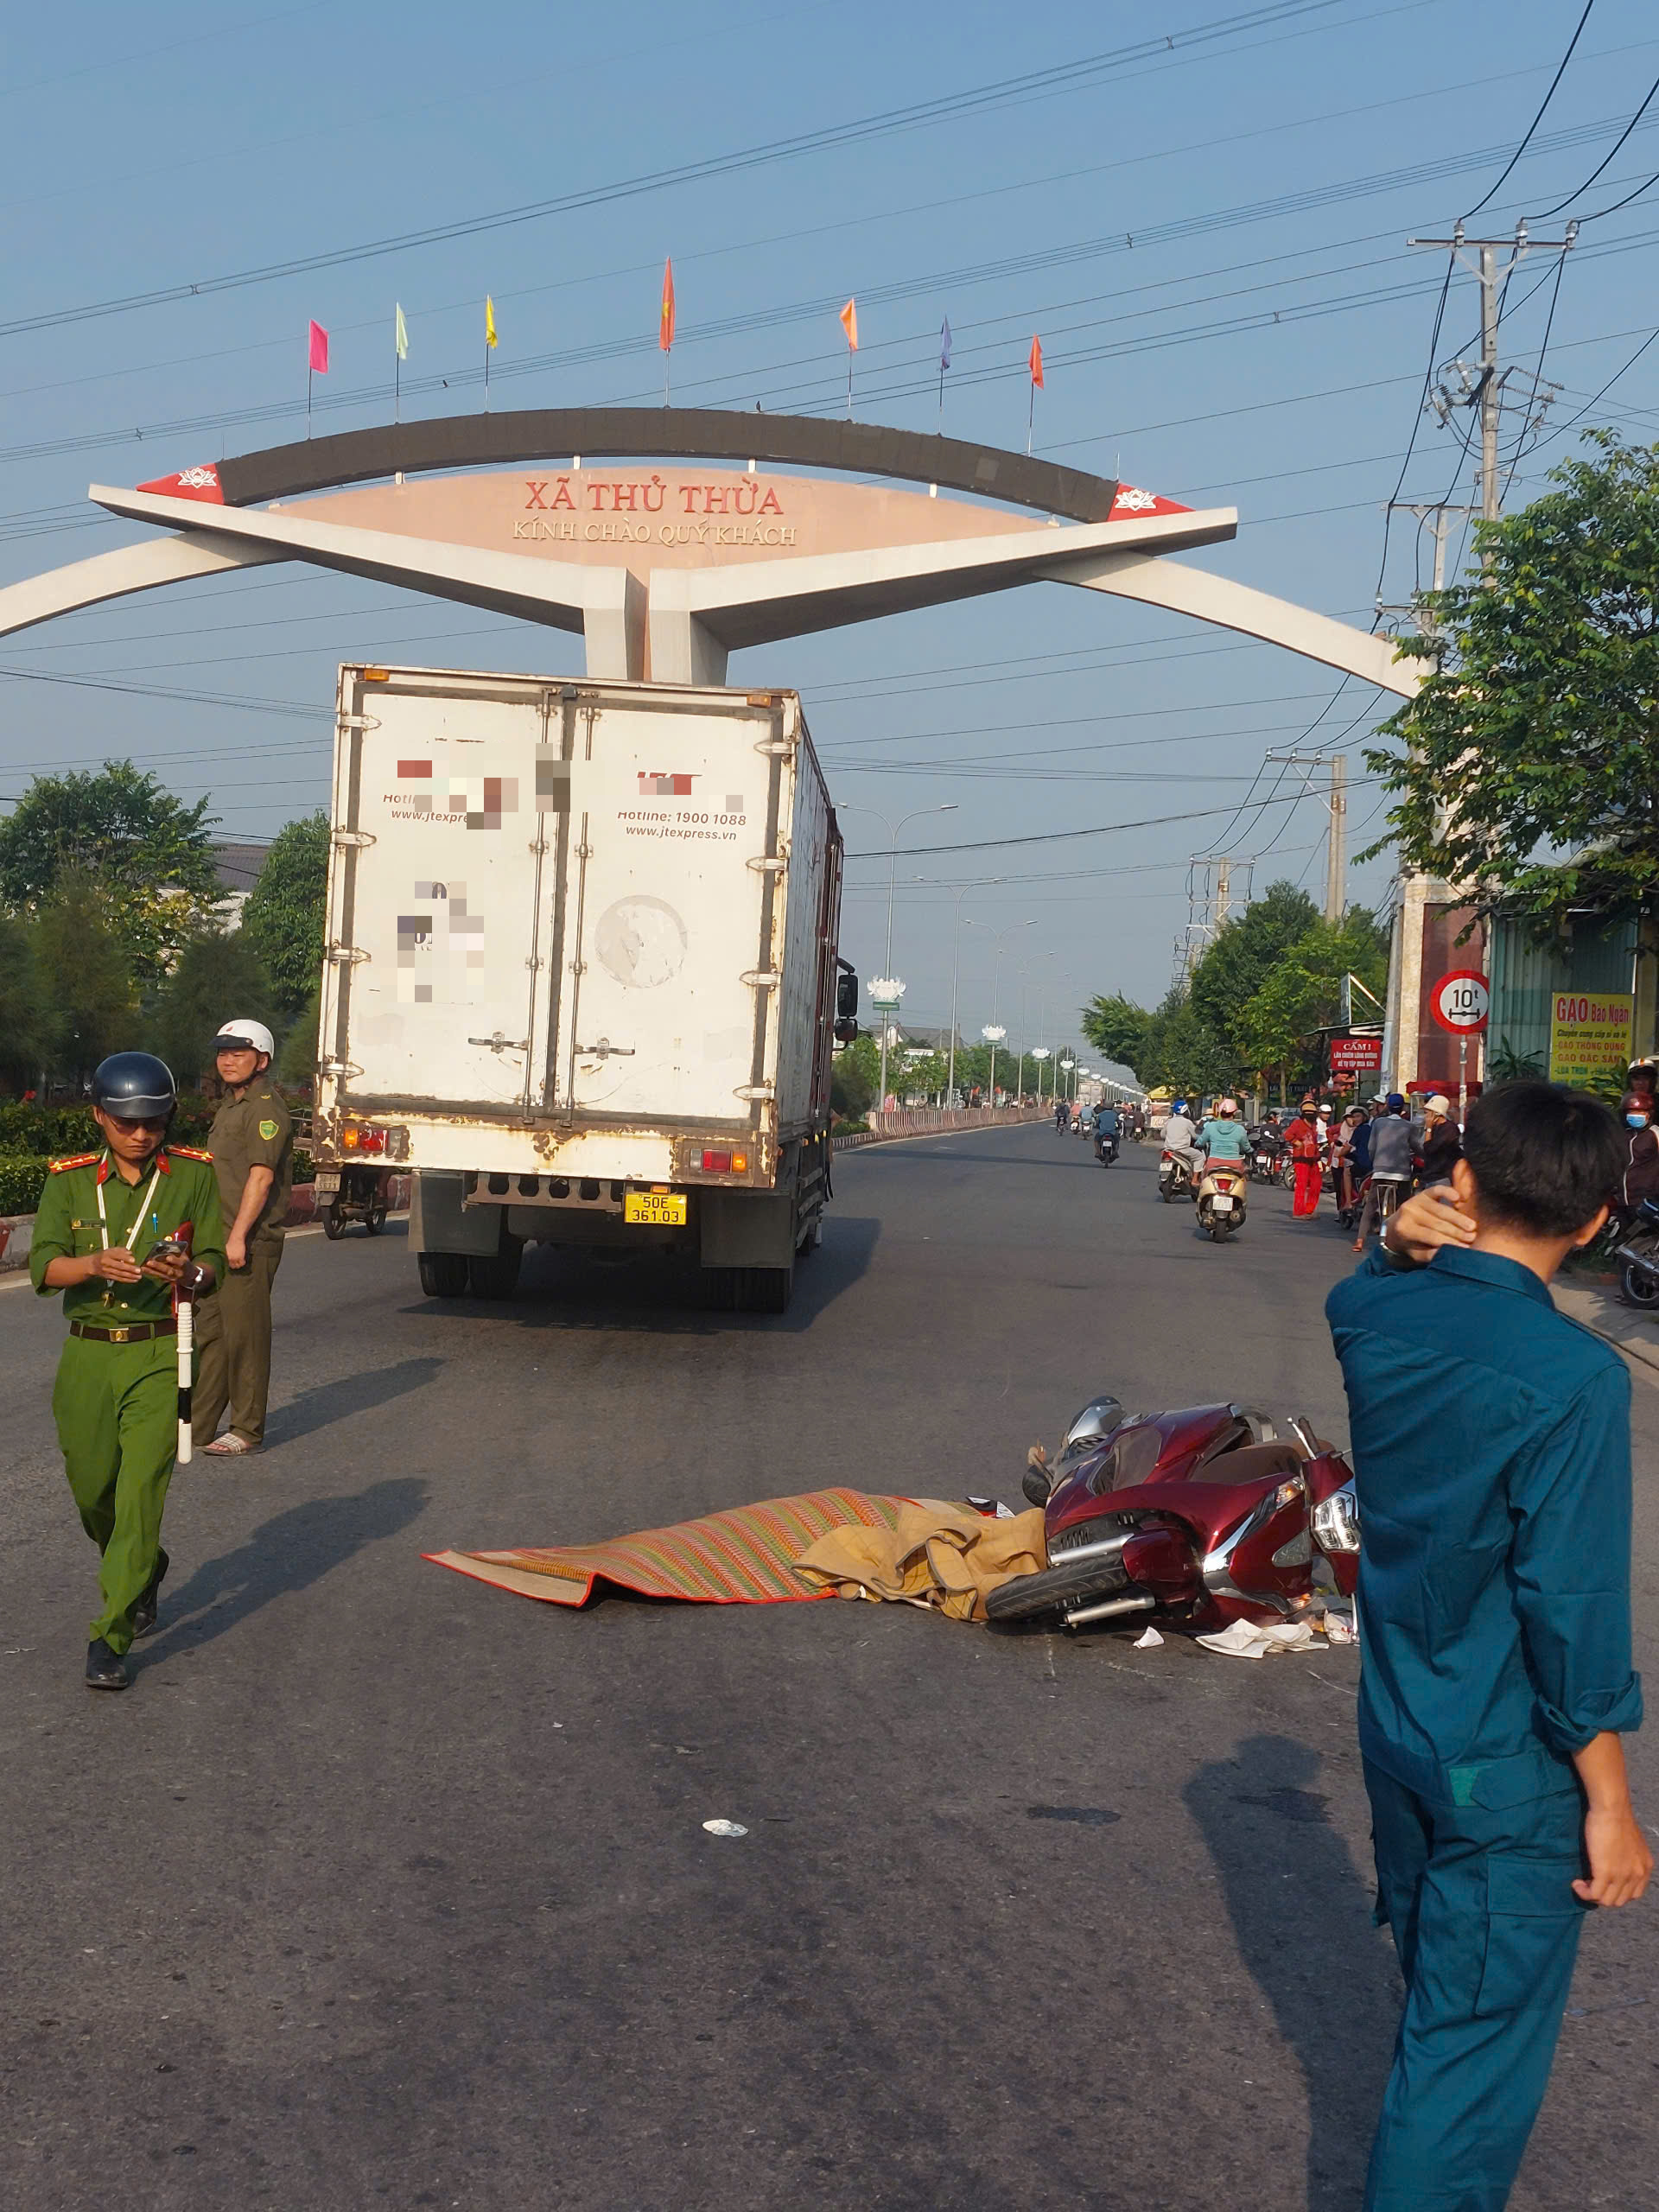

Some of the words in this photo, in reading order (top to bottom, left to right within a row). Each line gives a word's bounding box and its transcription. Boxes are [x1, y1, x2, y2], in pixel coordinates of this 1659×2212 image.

[524, 476, 577, 510] XÃ
[587, 474, 667, 512] THỦ
[679, 476, 785, 515] THỪA
[512, 516, 577, 542] KÍNH
[584, 517, 651, 543] CHÀO
[658, 519, 709, 548] QUÝ
[715, 519, 797, 547] KHÁCH
[676, 812, 709, 824] 1900
[713, 814, 747, 826] 1088
[626, 825, 737, 841] www.jtexpress.vn
[1556, 996, 1589, 1028] GẠO
[643, 1196, 669, 1209] 50E
[632, 1209, 679, 1223] 361.03
